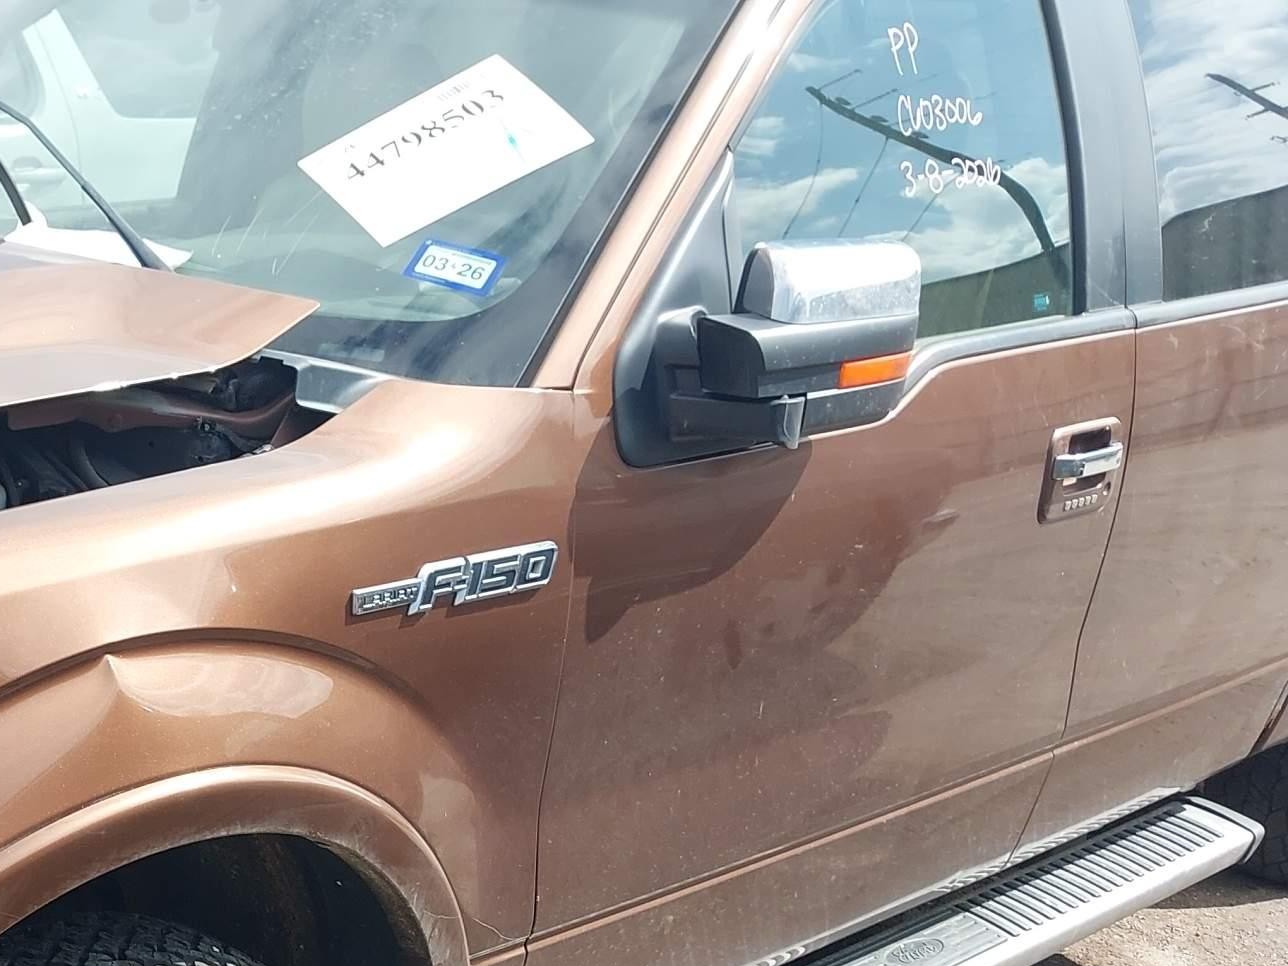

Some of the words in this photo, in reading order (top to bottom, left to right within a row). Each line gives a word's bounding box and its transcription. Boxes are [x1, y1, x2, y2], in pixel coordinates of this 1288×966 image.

[887, 21, 919, 77] PP
[347, 89, 505, 180] 44798503
[900, 157, 1002, 198] 3-8-2026
